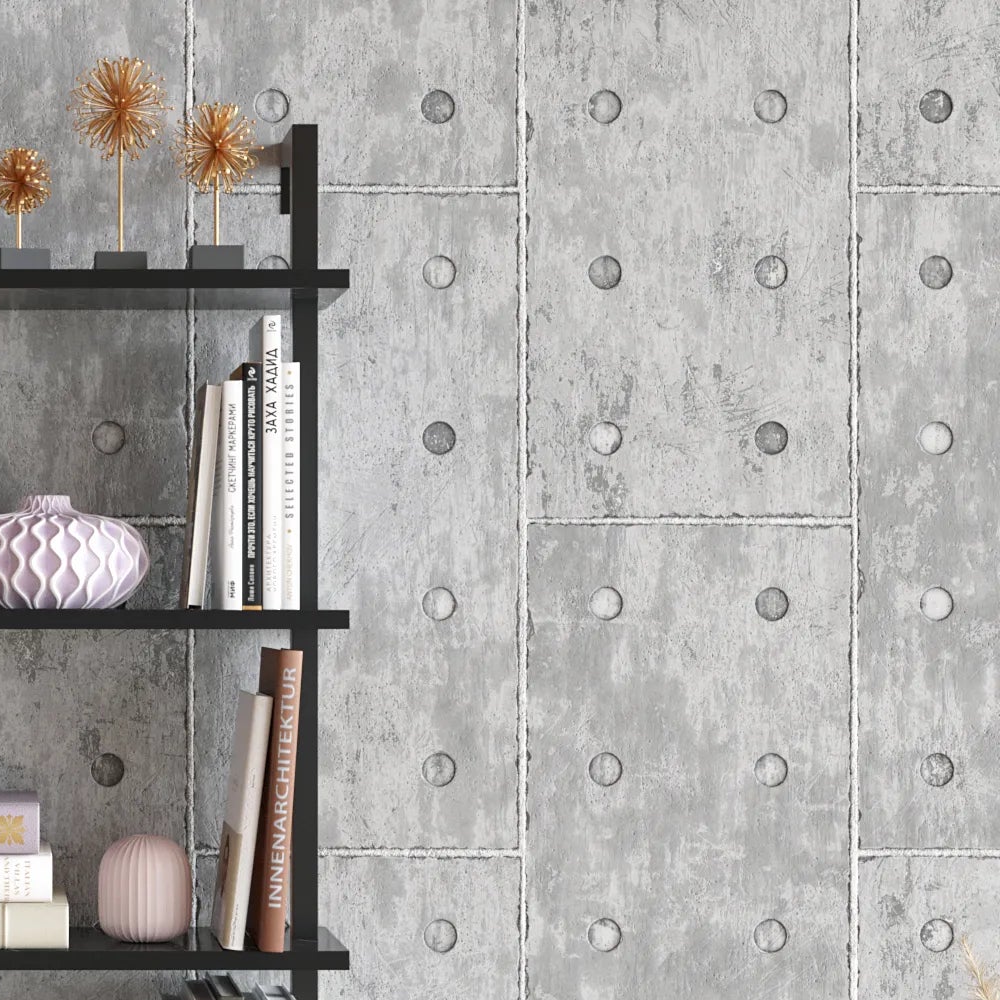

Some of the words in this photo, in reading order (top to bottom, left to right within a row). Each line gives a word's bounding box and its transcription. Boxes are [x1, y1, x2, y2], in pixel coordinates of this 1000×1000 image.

[265, 348, 279, 394] ХАДИД
[247, 385, 256, 418] РИСОВАТЬ
[265, 401, 278, 434] ЗАХА
[284, 384, 294, 442] STORIES
[227, 403, 237, 451] МАРКЕРАМИ
[247, 419, 256, 440] КРУТО
[227, 454, 237, 493] СКЕТЧИНГ
[247, 441, 256, 478] НАУЧИТЬСЯ
[247, 478, 256, 504] ХОЧЕШЬ
[284, 452, 294, 518] SELECTED
[247, 505, 256, 520] ЕСЛИ
[247, 535, 256, 559] ПРОЧТИ
[268, 667, 297, 909] INNENARCHITEKTUR
